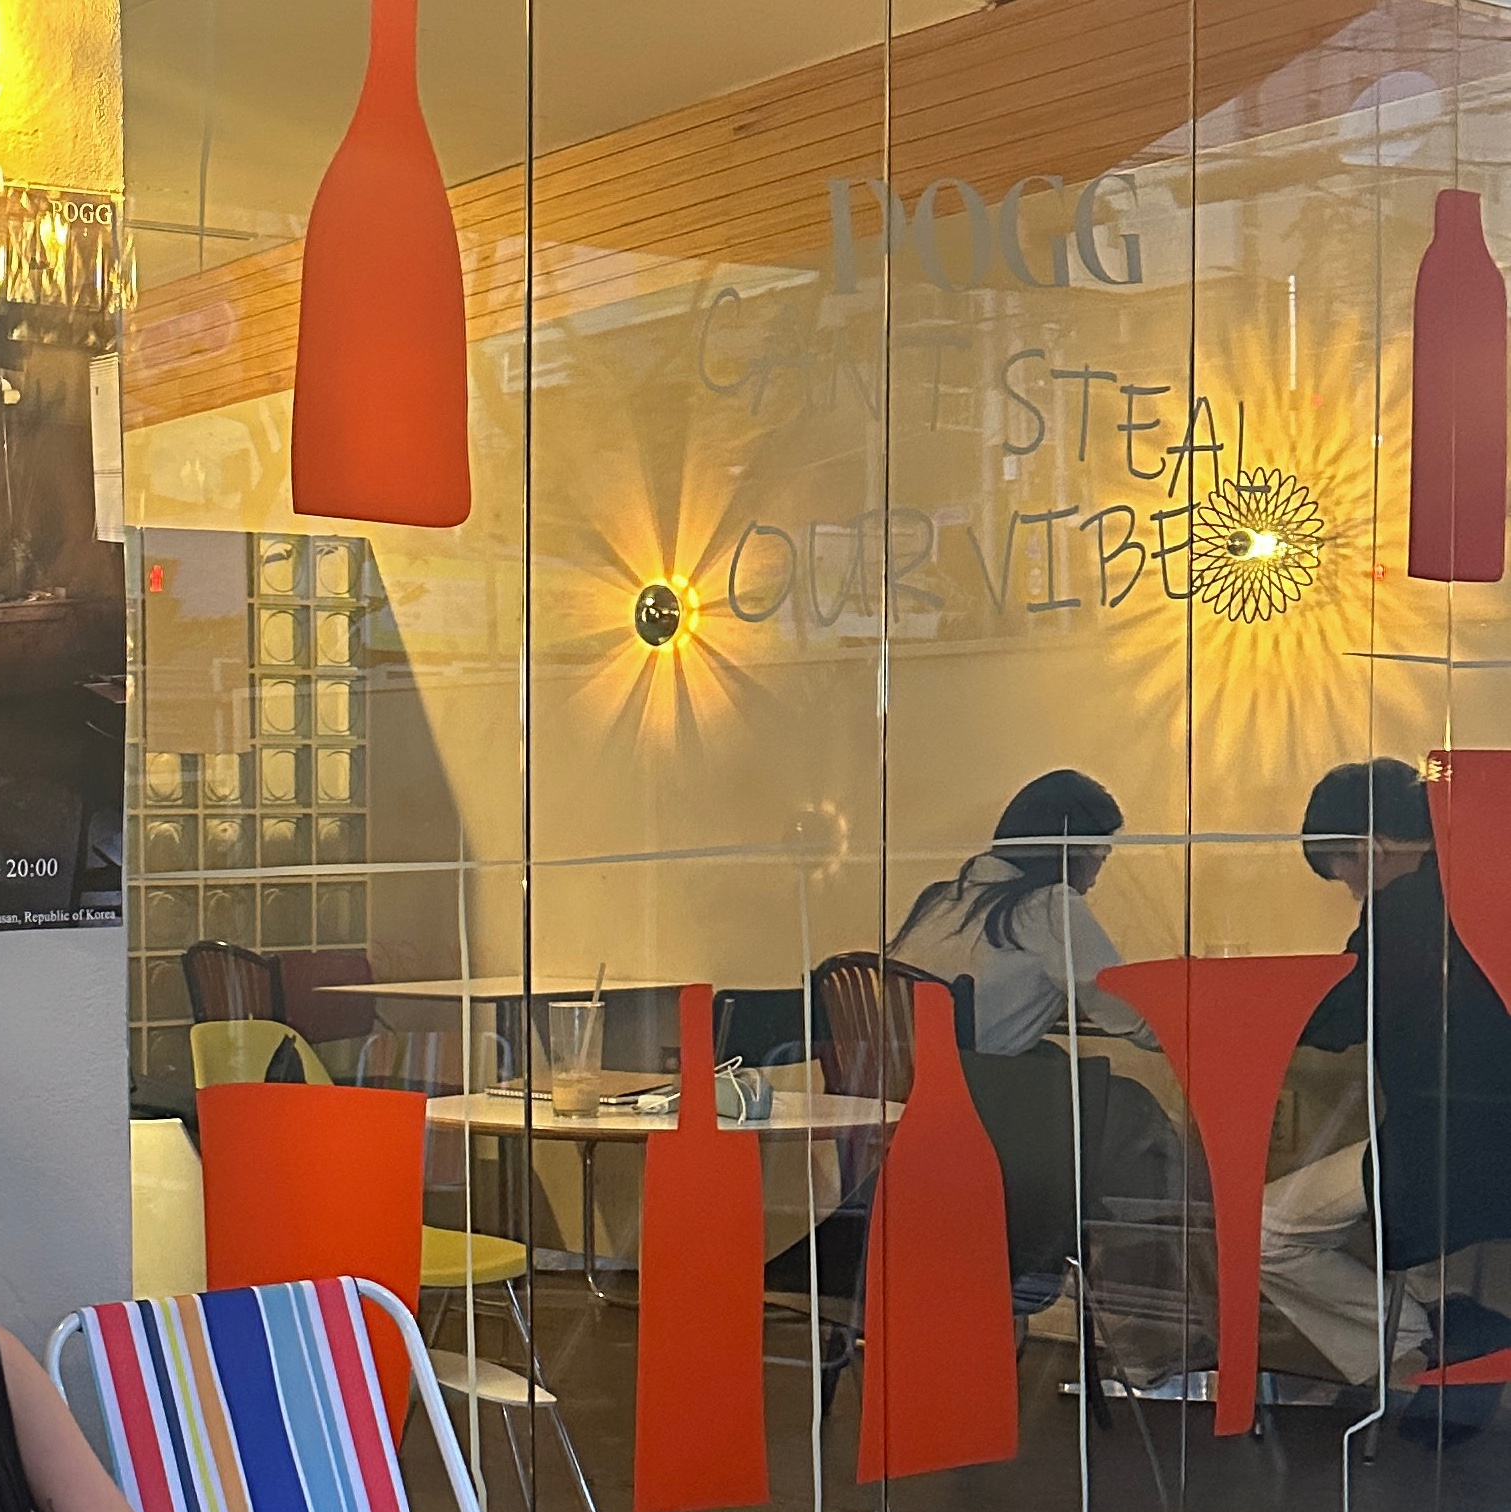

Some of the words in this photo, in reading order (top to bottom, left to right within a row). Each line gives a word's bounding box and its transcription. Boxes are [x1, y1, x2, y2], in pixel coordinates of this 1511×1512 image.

[50, 200, 113, 225] POGG
[826, 174, 1144, 293] POGG
[1002, 348, 1272, 501] STEAL
[728, 507, 945, 627] OUR
[968, 501, 1206, 614] VIBE
[6, 858, 59, 878] 20:00
[24, 910, 70, 924] Republic
[72, 909, 85, 921] of
[86, 909, 116, 921] Korea
